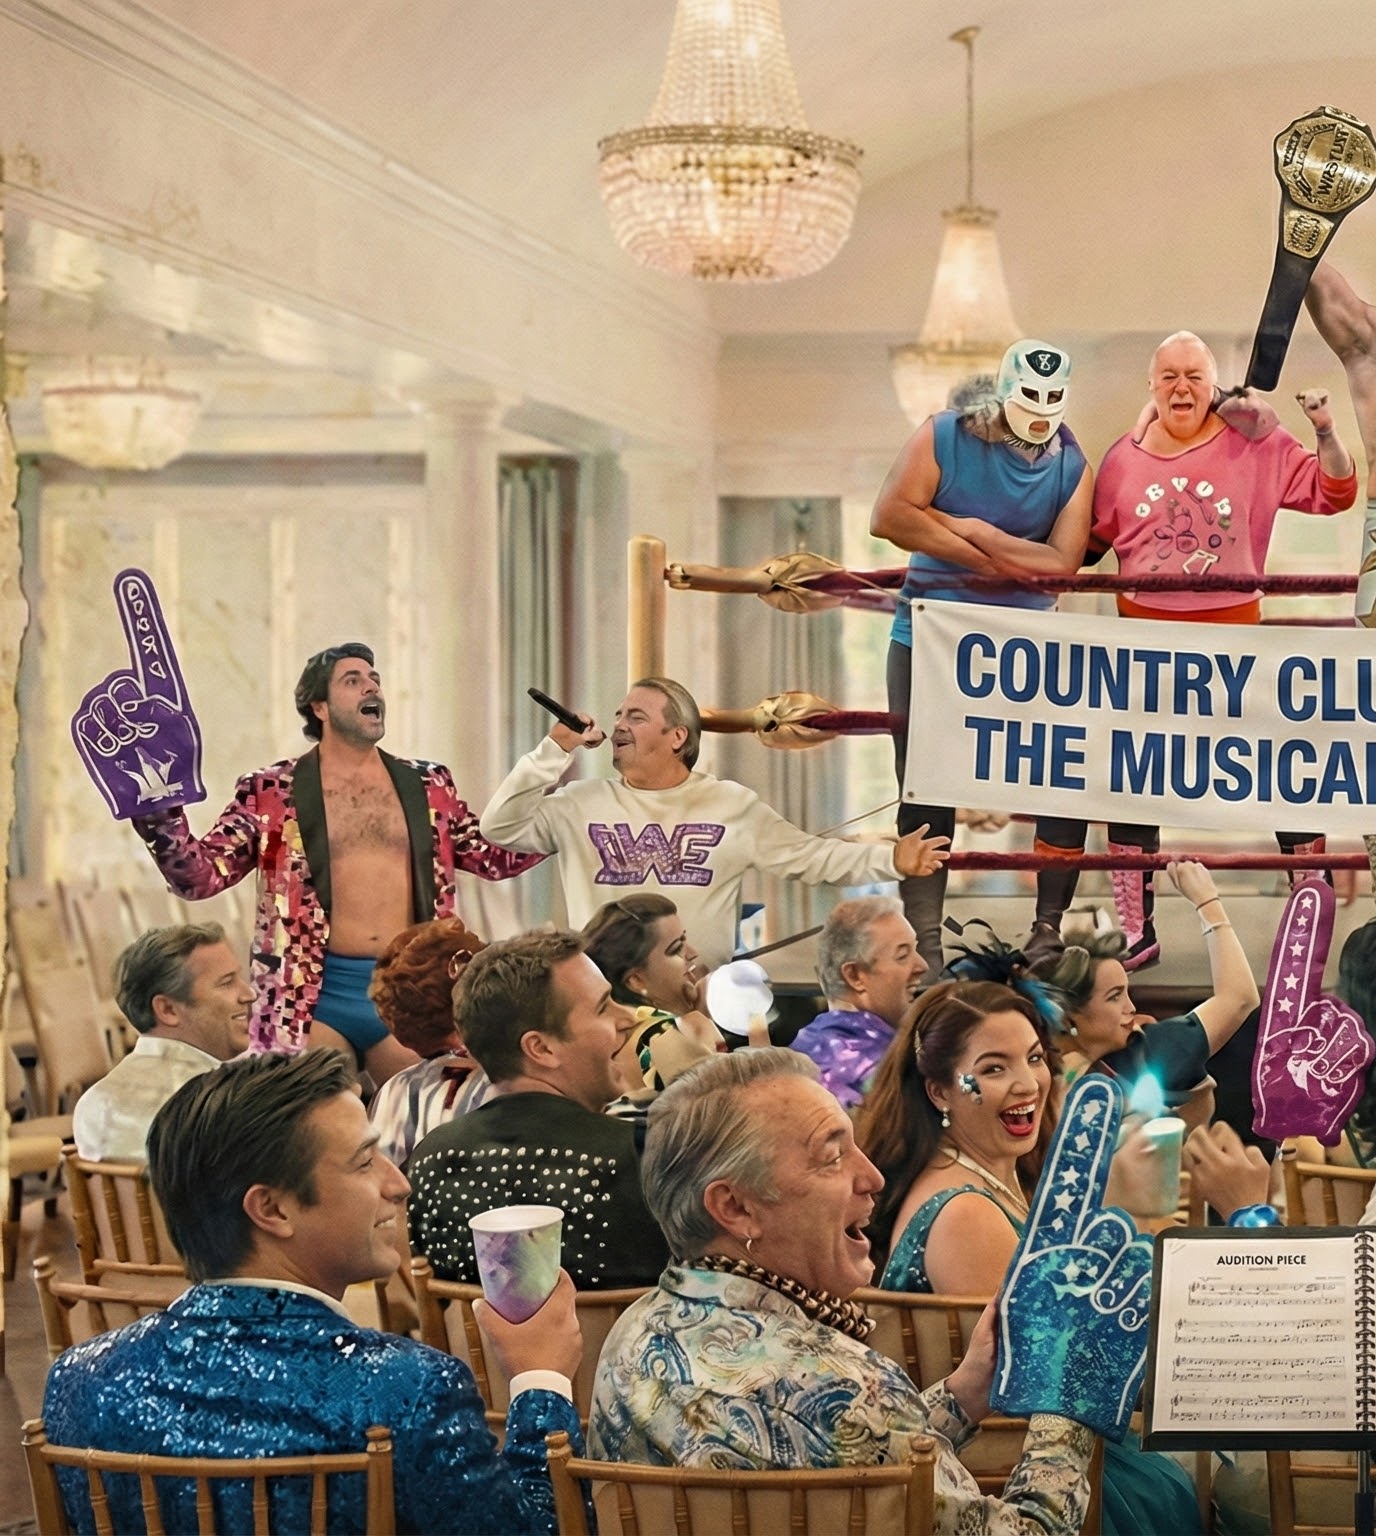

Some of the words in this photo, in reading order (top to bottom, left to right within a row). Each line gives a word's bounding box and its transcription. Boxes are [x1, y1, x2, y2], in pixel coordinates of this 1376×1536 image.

[956, 633, 1258, 720] COUNTRY
[964, 715, 1088, 791] THE
[1216, 1255, 1273, 1266] AUDITION
[1277, 1255, 1307, 1266] PIECE
